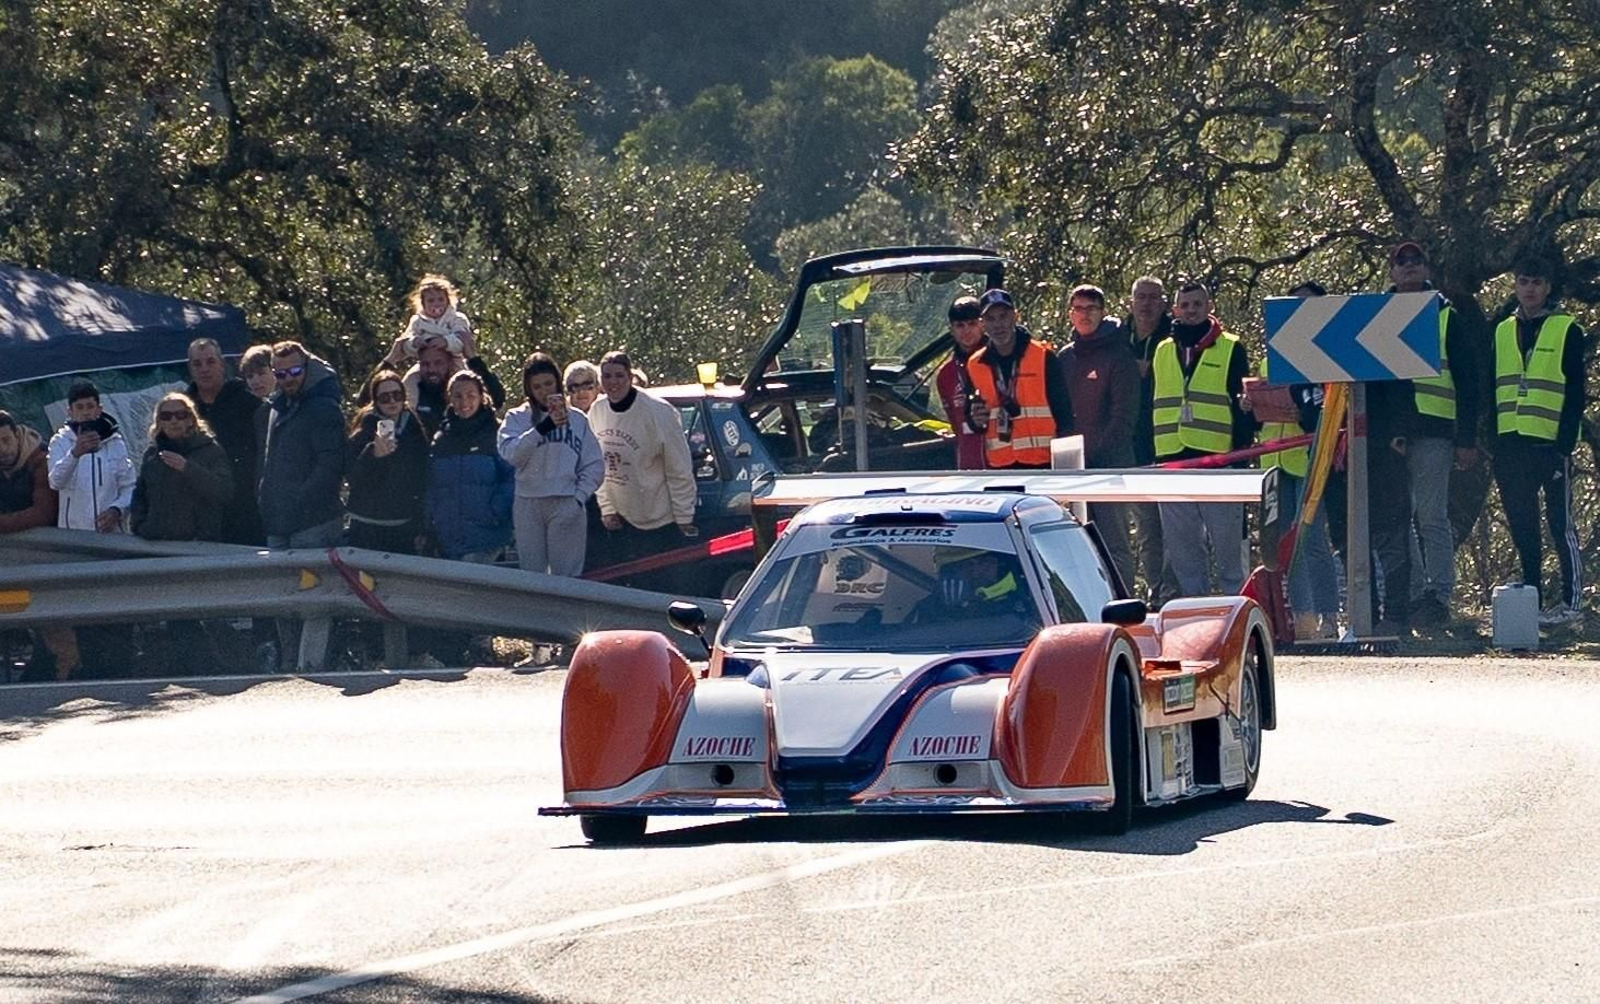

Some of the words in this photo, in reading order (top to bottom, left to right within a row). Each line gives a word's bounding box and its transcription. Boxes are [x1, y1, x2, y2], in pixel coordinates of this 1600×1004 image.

[830, 525, 957, 539] GALFRES
[682, 736, 756, 756] AZOCHE
[909, 735, 982, 756] AZOCHE
